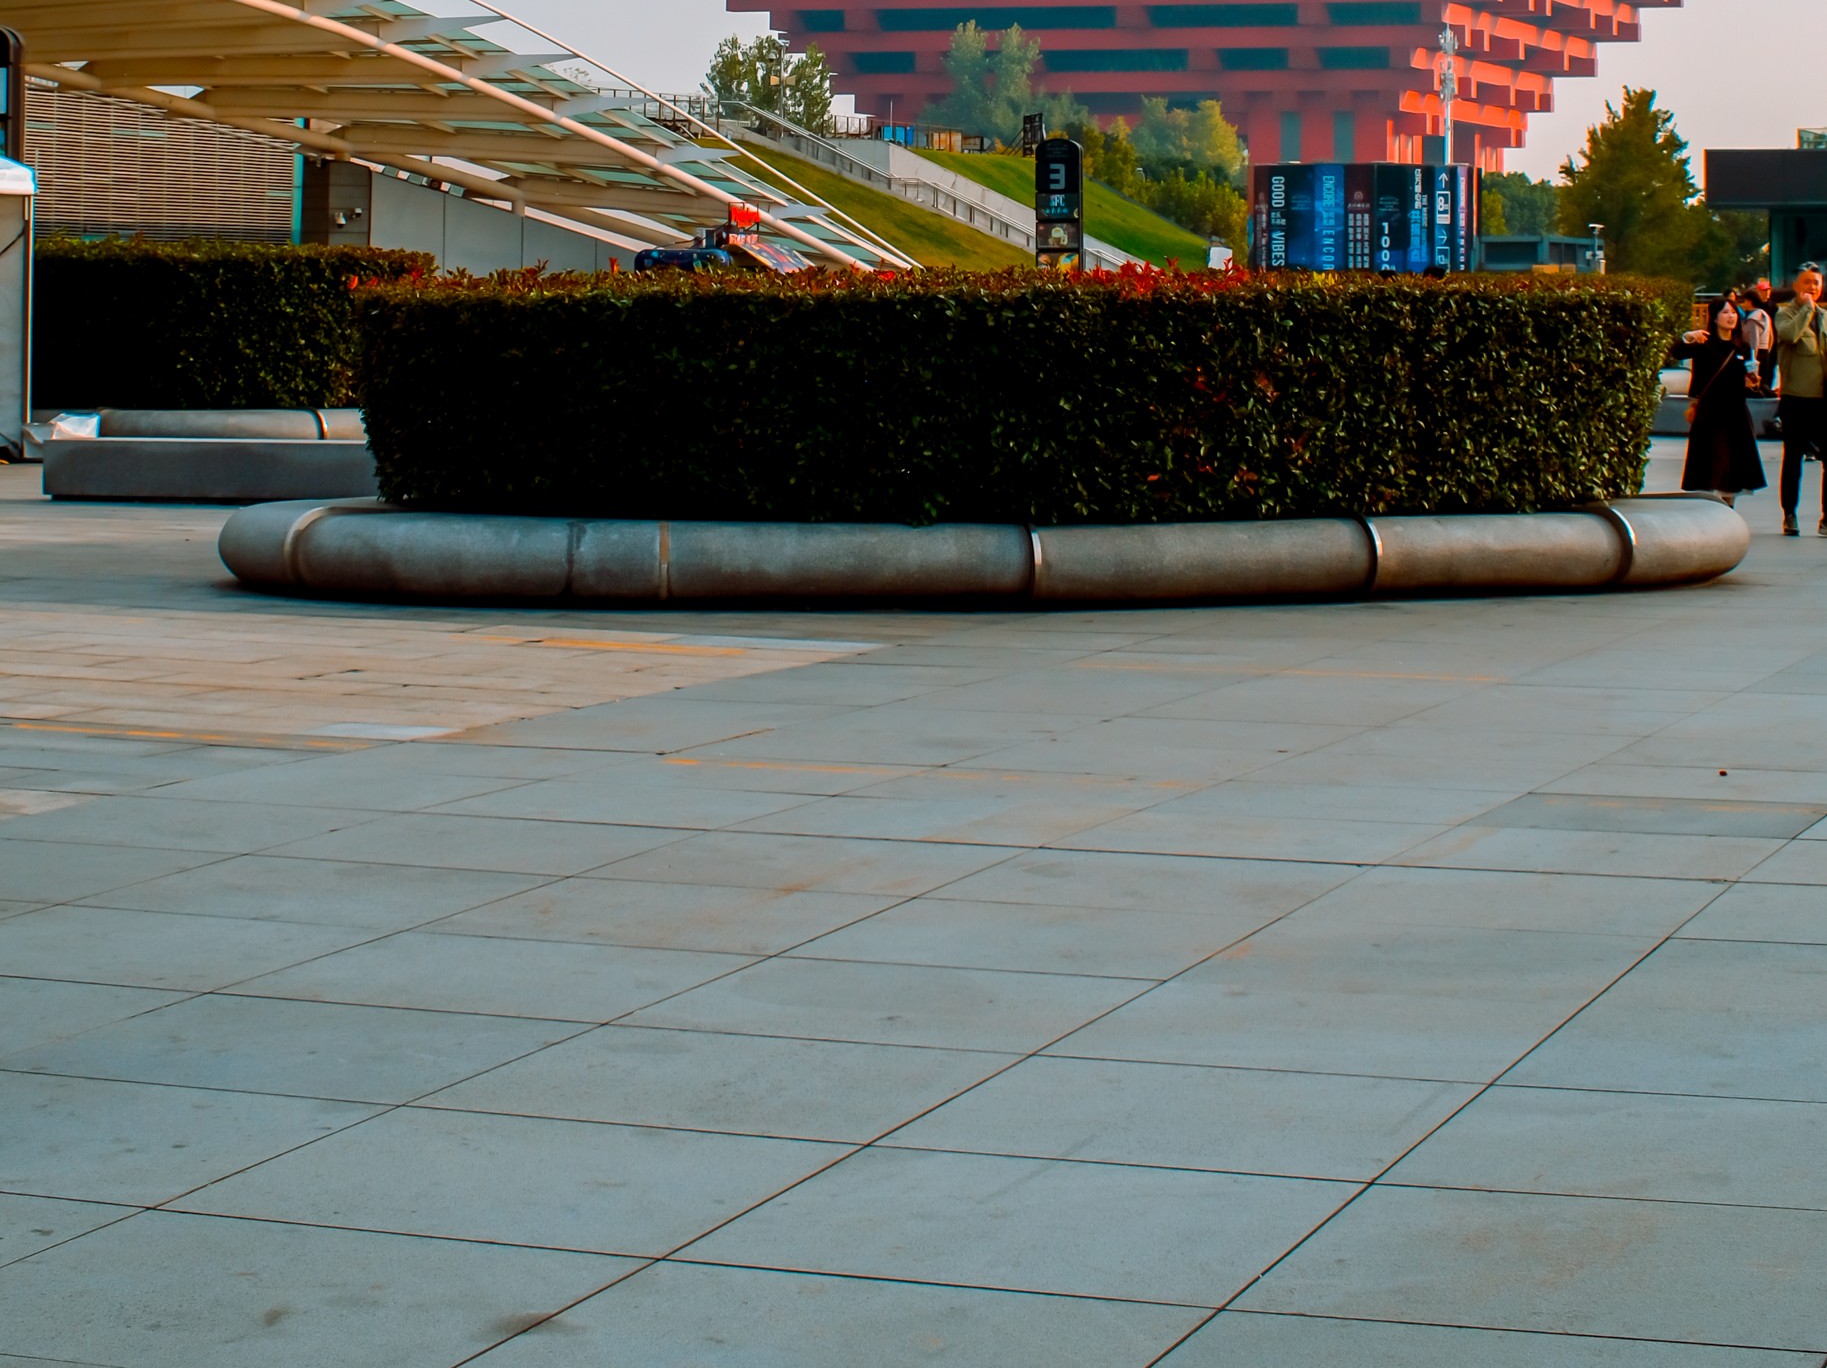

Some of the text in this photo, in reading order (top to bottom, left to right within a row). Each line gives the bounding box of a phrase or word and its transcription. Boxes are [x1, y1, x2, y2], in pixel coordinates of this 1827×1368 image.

[1050, 163, 1066, 190] 3
[1271, 176, 1285, 208] GOOD
[1322, 175, 1335, 207] ENCORE
[1049, 194, 1065, 207] SFC
[1271, 231, 1285, 267] VIBES
